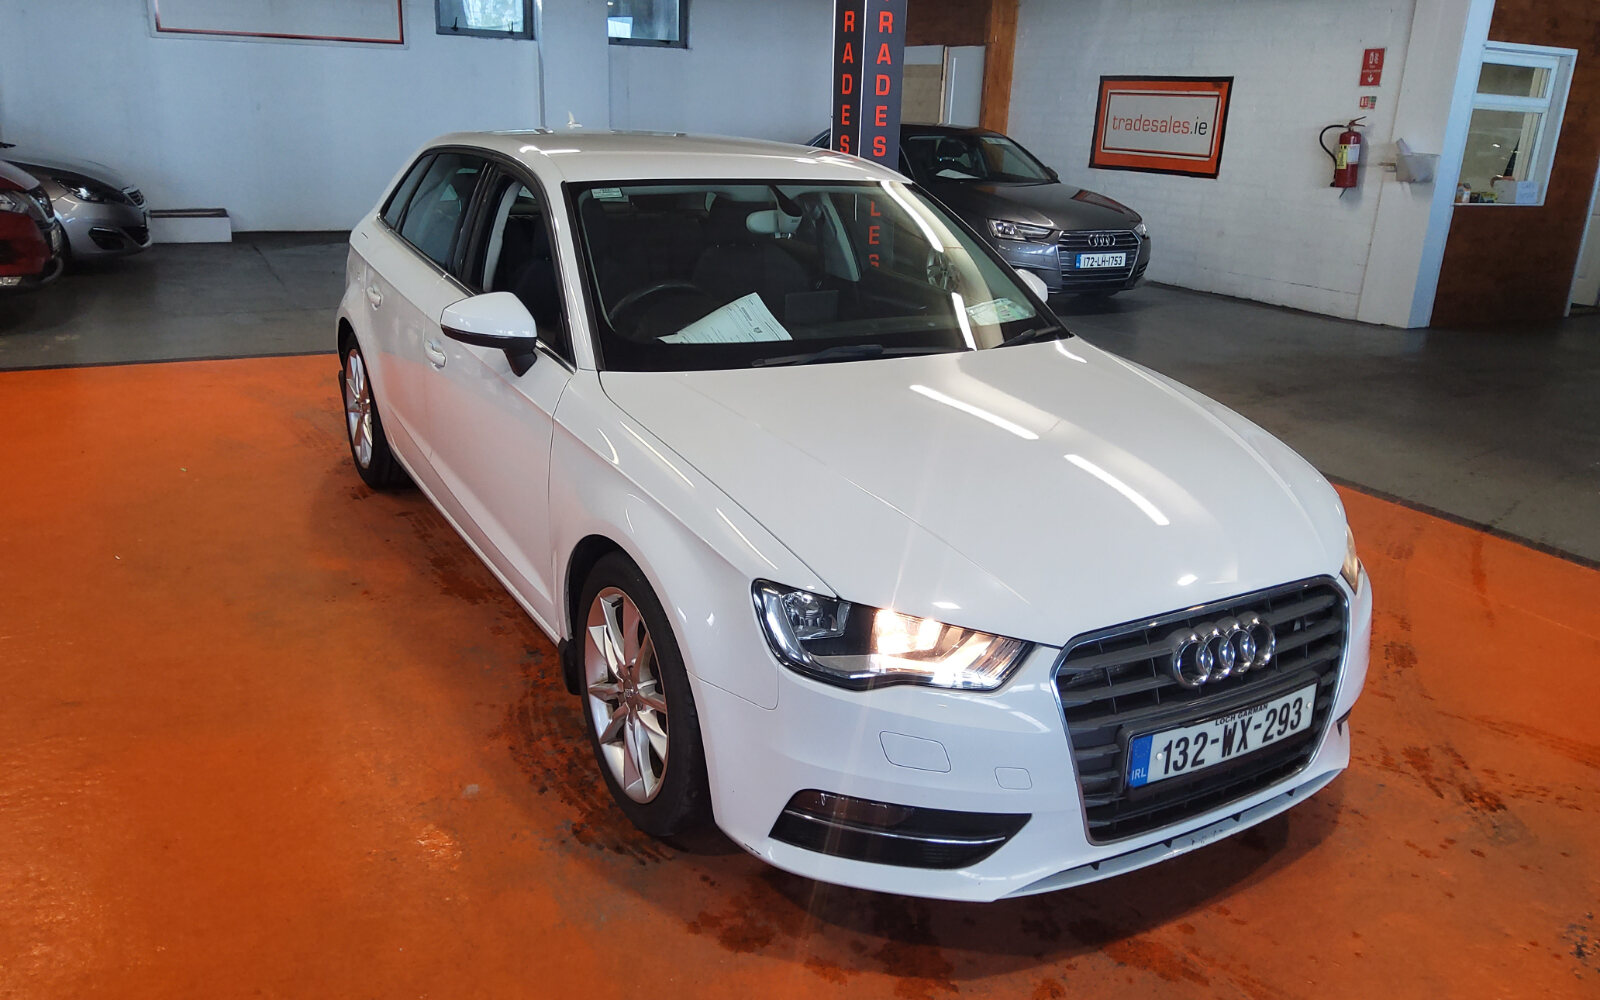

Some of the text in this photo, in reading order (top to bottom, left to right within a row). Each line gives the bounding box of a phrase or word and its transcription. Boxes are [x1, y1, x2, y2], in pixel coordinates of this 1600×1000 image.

[872, 0, 894, 157] RADES
[1112, 114, 1208, 136] tradesales.ie
[1083, 256, 1123, 267] 172-LH-1753
[1215, 703, 1269, 726] LOCH GARMAN
[1163, 697, 1304, 775] 132-WX-293
[1131, 768, 1148, 781] IRL
